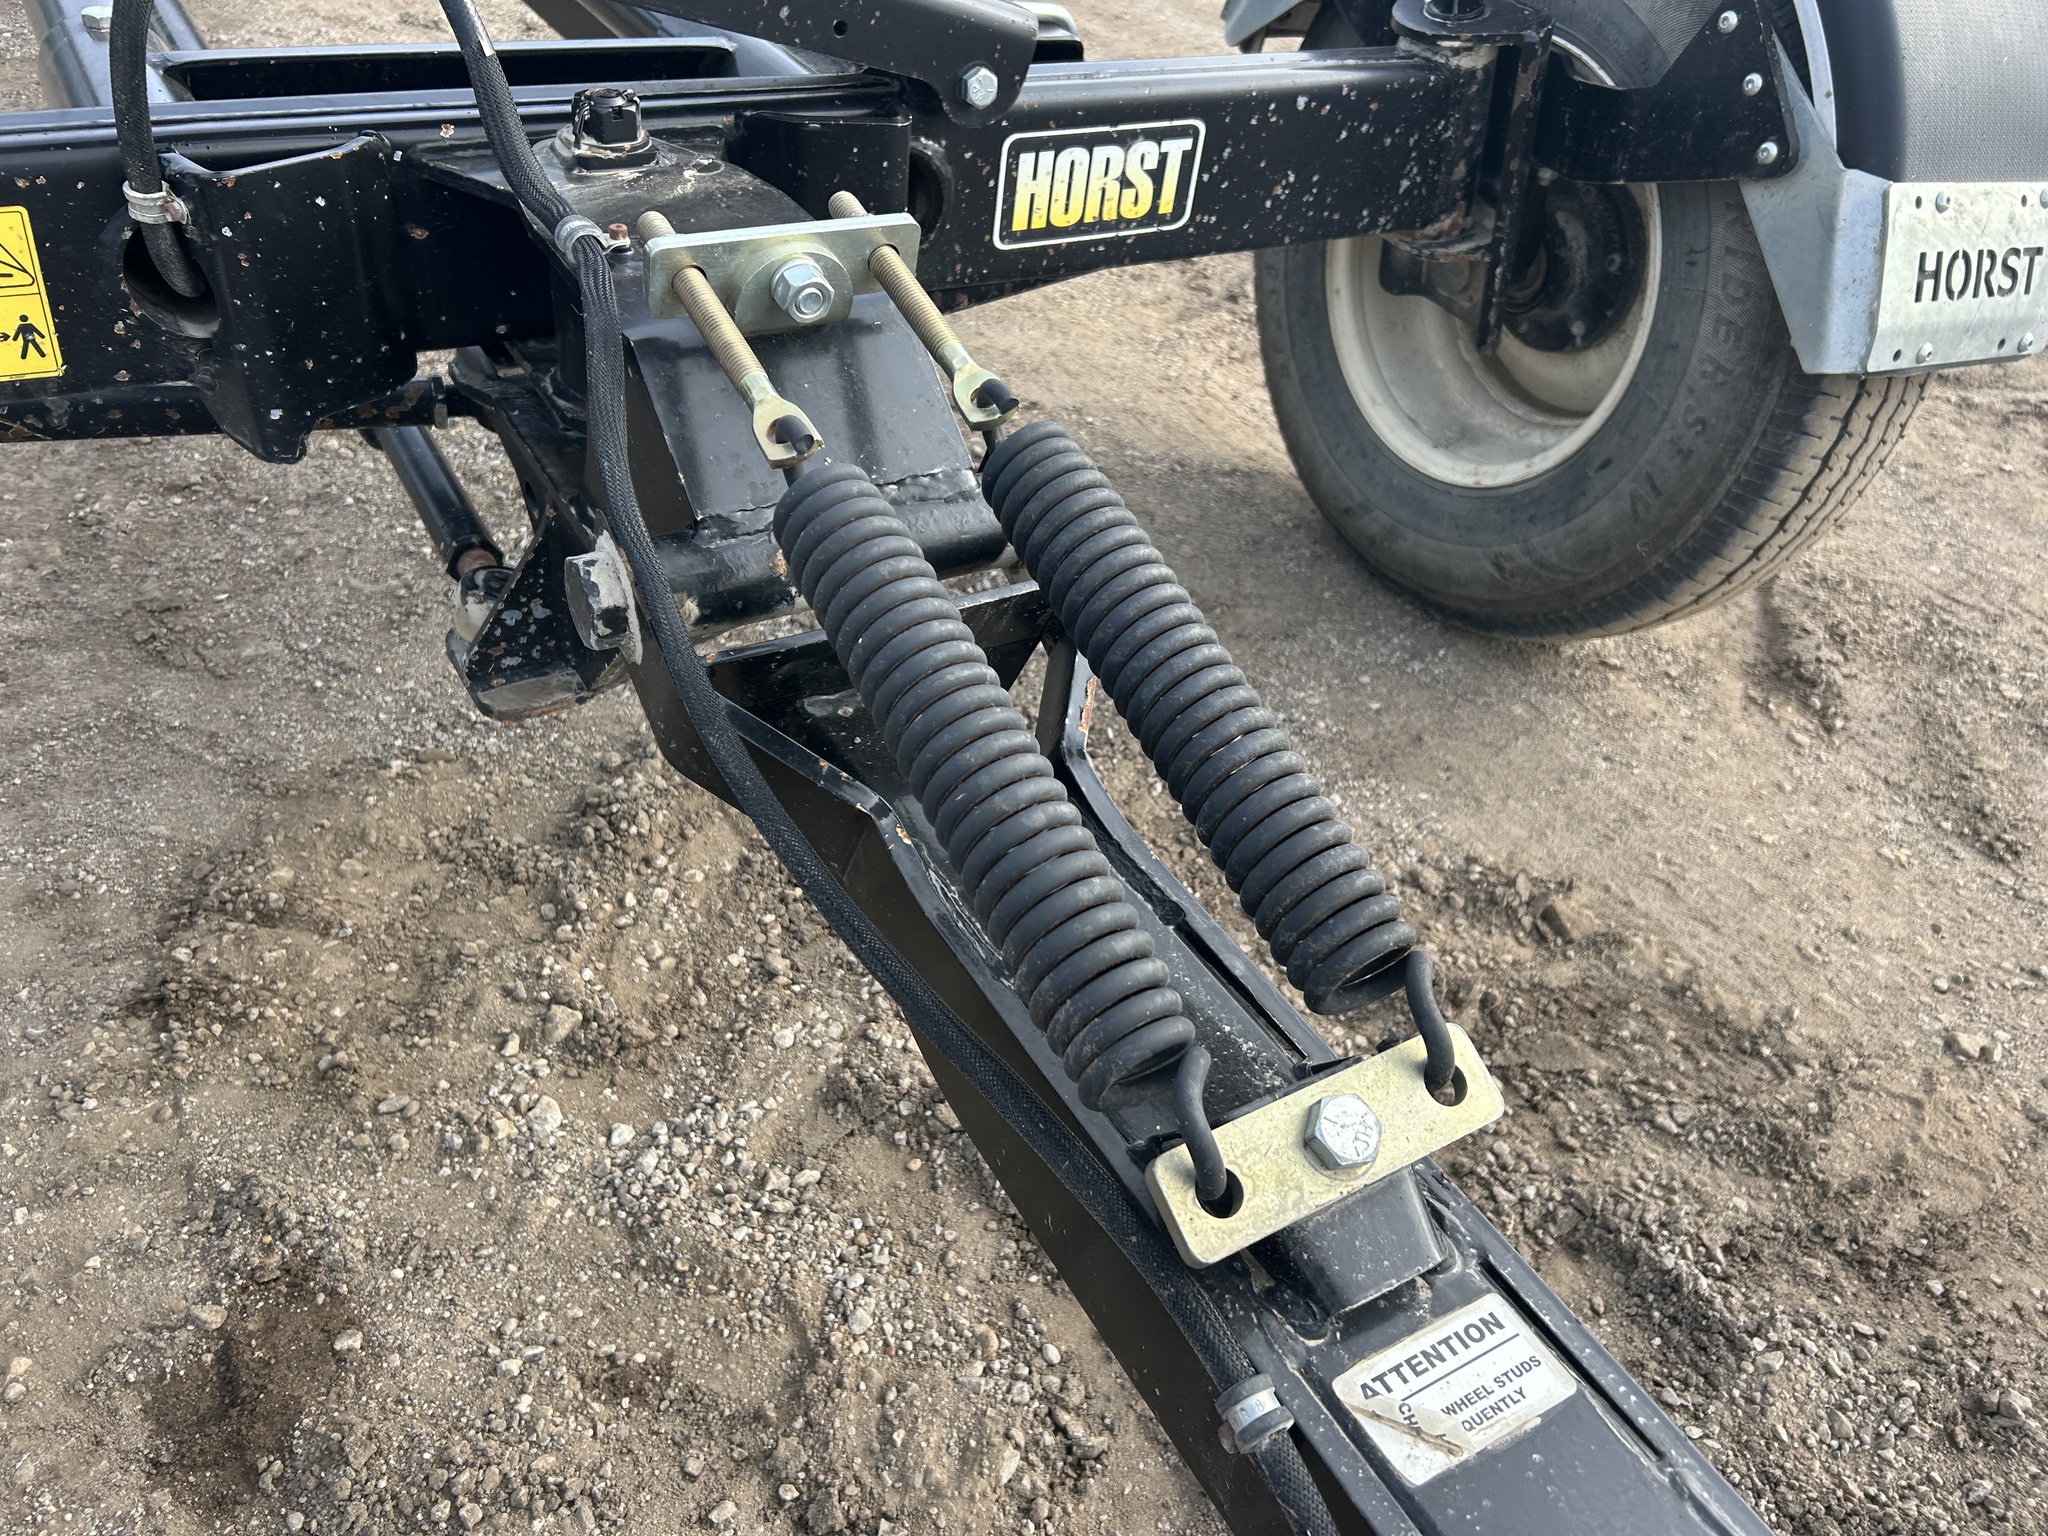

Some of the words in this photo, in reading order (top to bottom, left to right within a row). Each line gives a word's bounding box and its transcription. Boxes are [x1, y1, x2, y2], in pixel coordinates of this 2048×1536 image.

[1012, 138, 1194, 232] HORST
[1914, 246, 2045, 304] HORST
[1359, 1311, 1506, 1400] ATTENTION
[1440, 1384, 1496, 1417] WHEEL
[1493, 1355, 1542, 1390] STUDS
